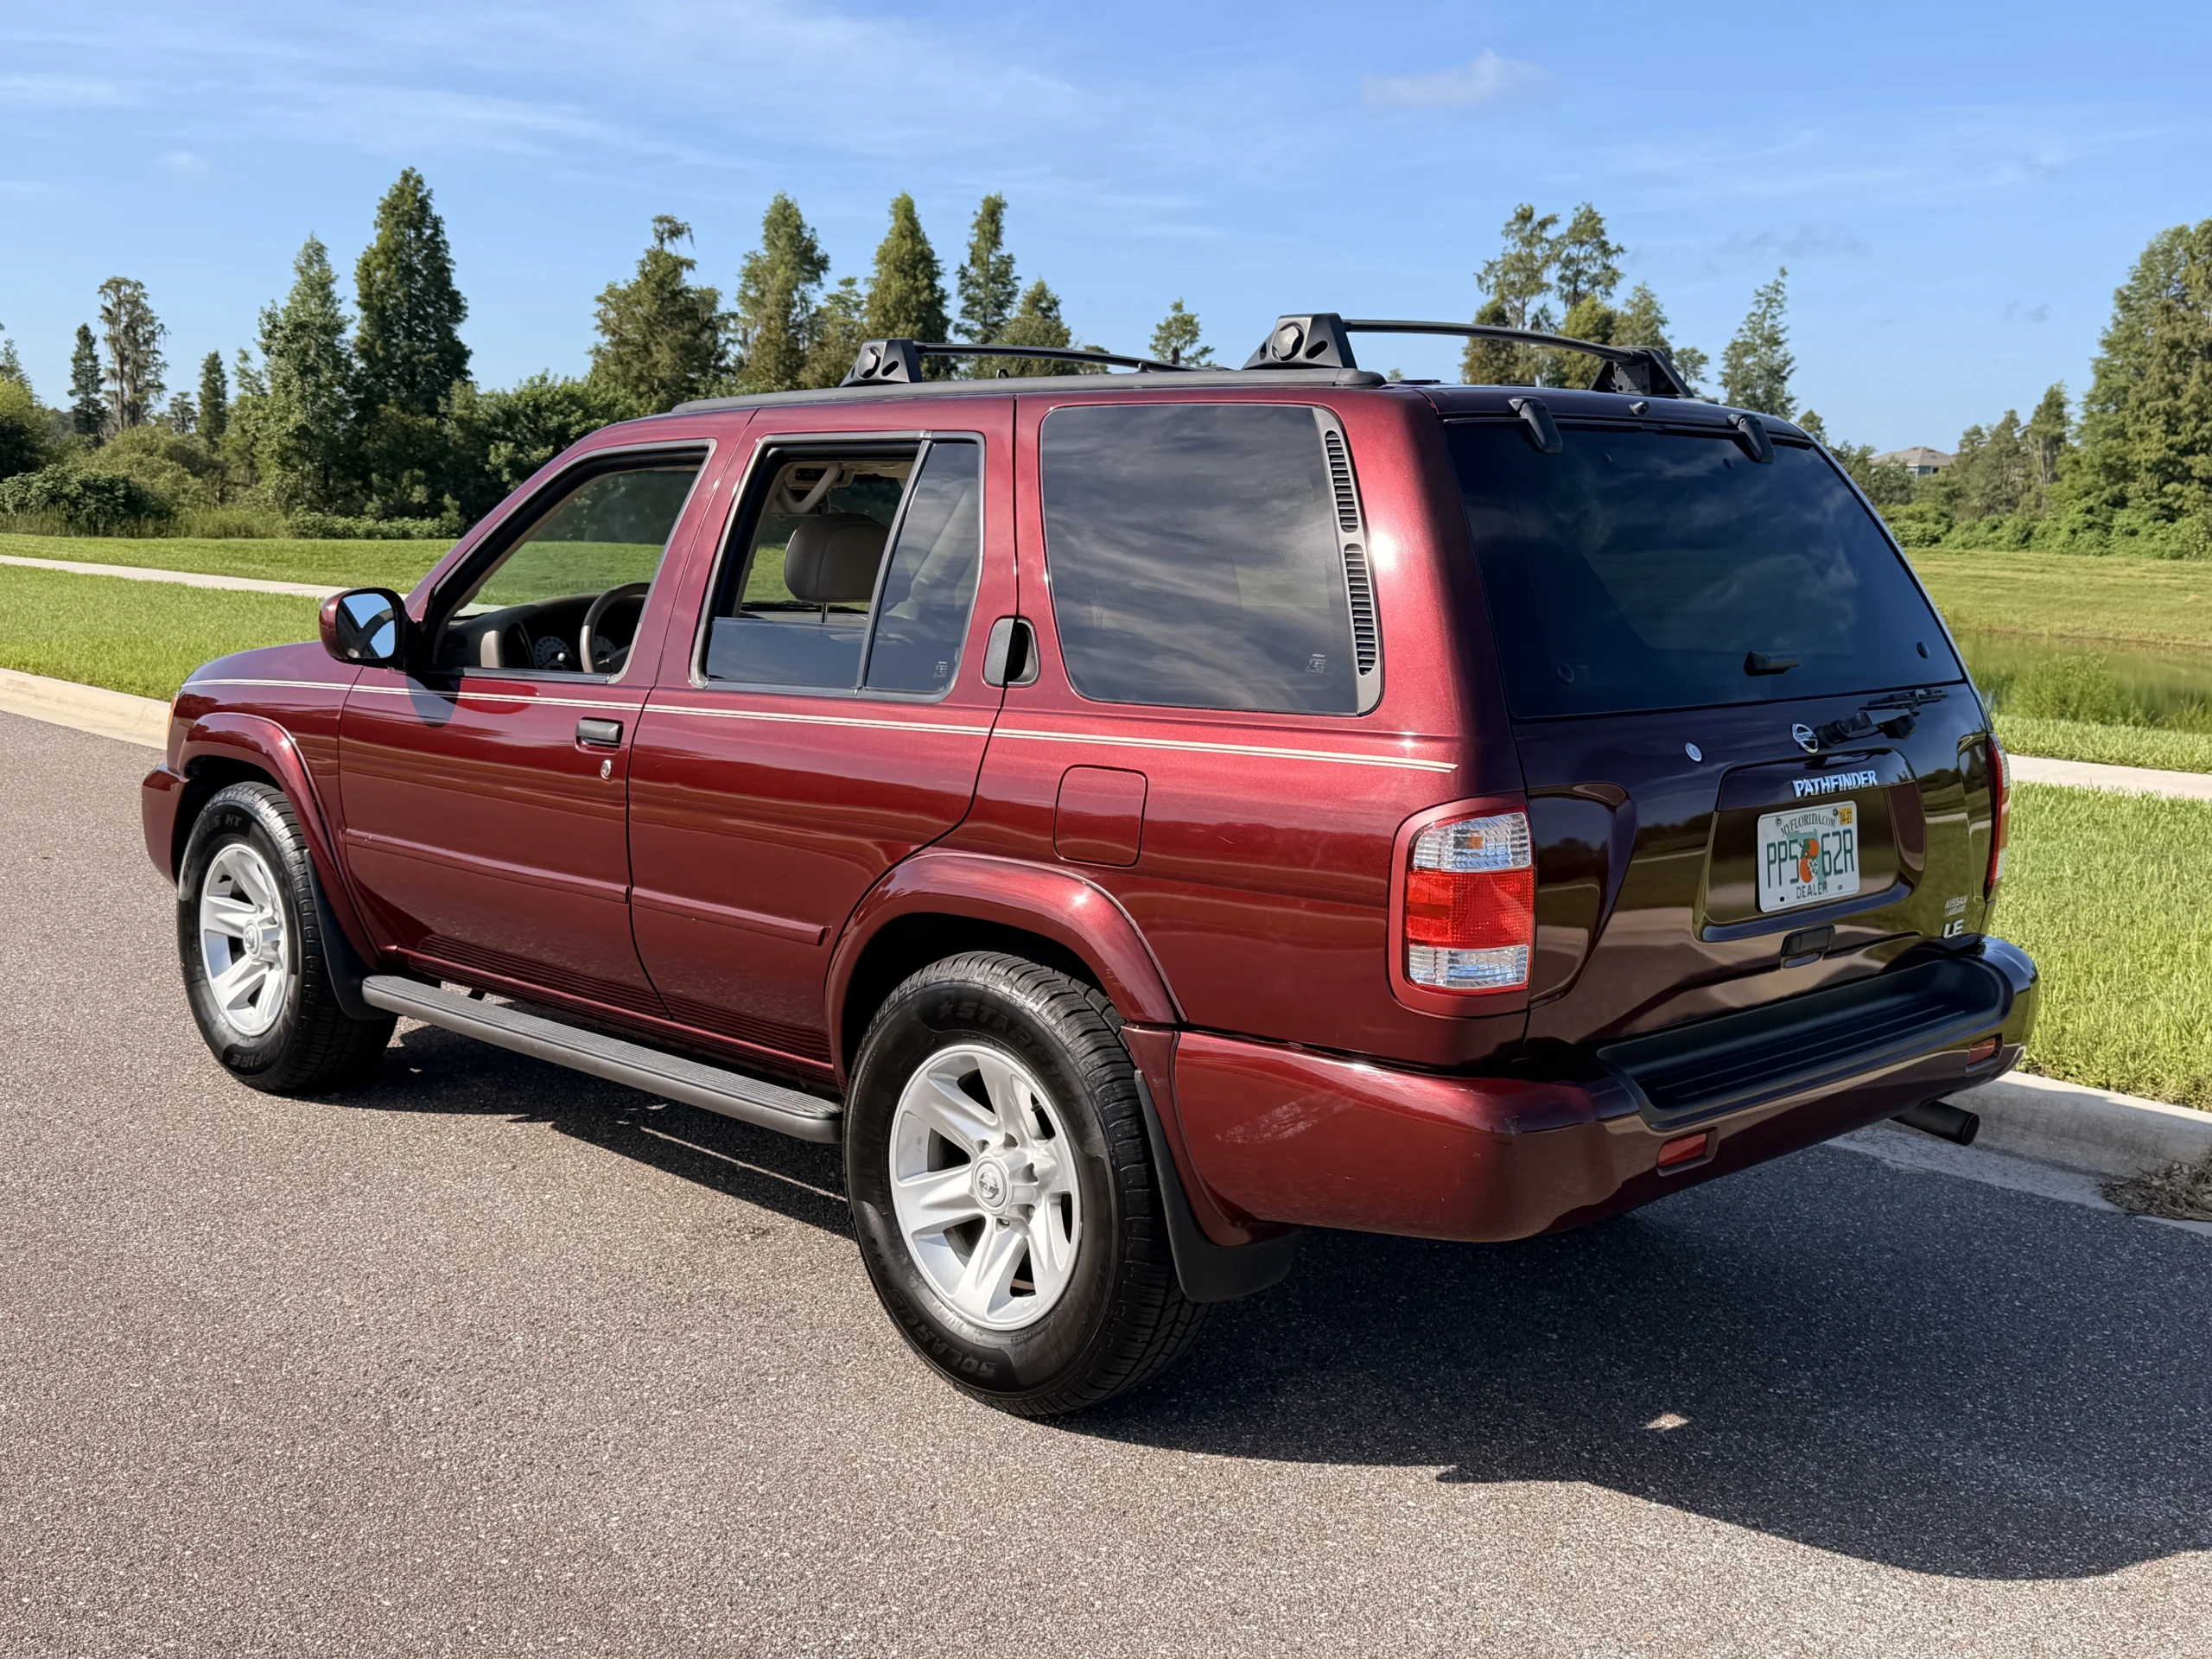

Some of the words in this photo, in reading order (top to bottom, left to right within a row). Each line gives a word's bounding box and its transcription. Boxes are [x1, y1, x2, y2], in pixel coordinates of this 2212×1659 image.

[1793, 770, 1878, 798] PATHFINDER
[1781, 813, 1836, 836] MYFLORIDA.COM
[1766, 838, 1800, 889] PP5
[1821, 828, 1855, 878] 62R
[1796, 881, 1828, 899] DEALER
[1942, 918, 1964, 939] LE
[887, 1288, 1001, 1378] SOLARUS
